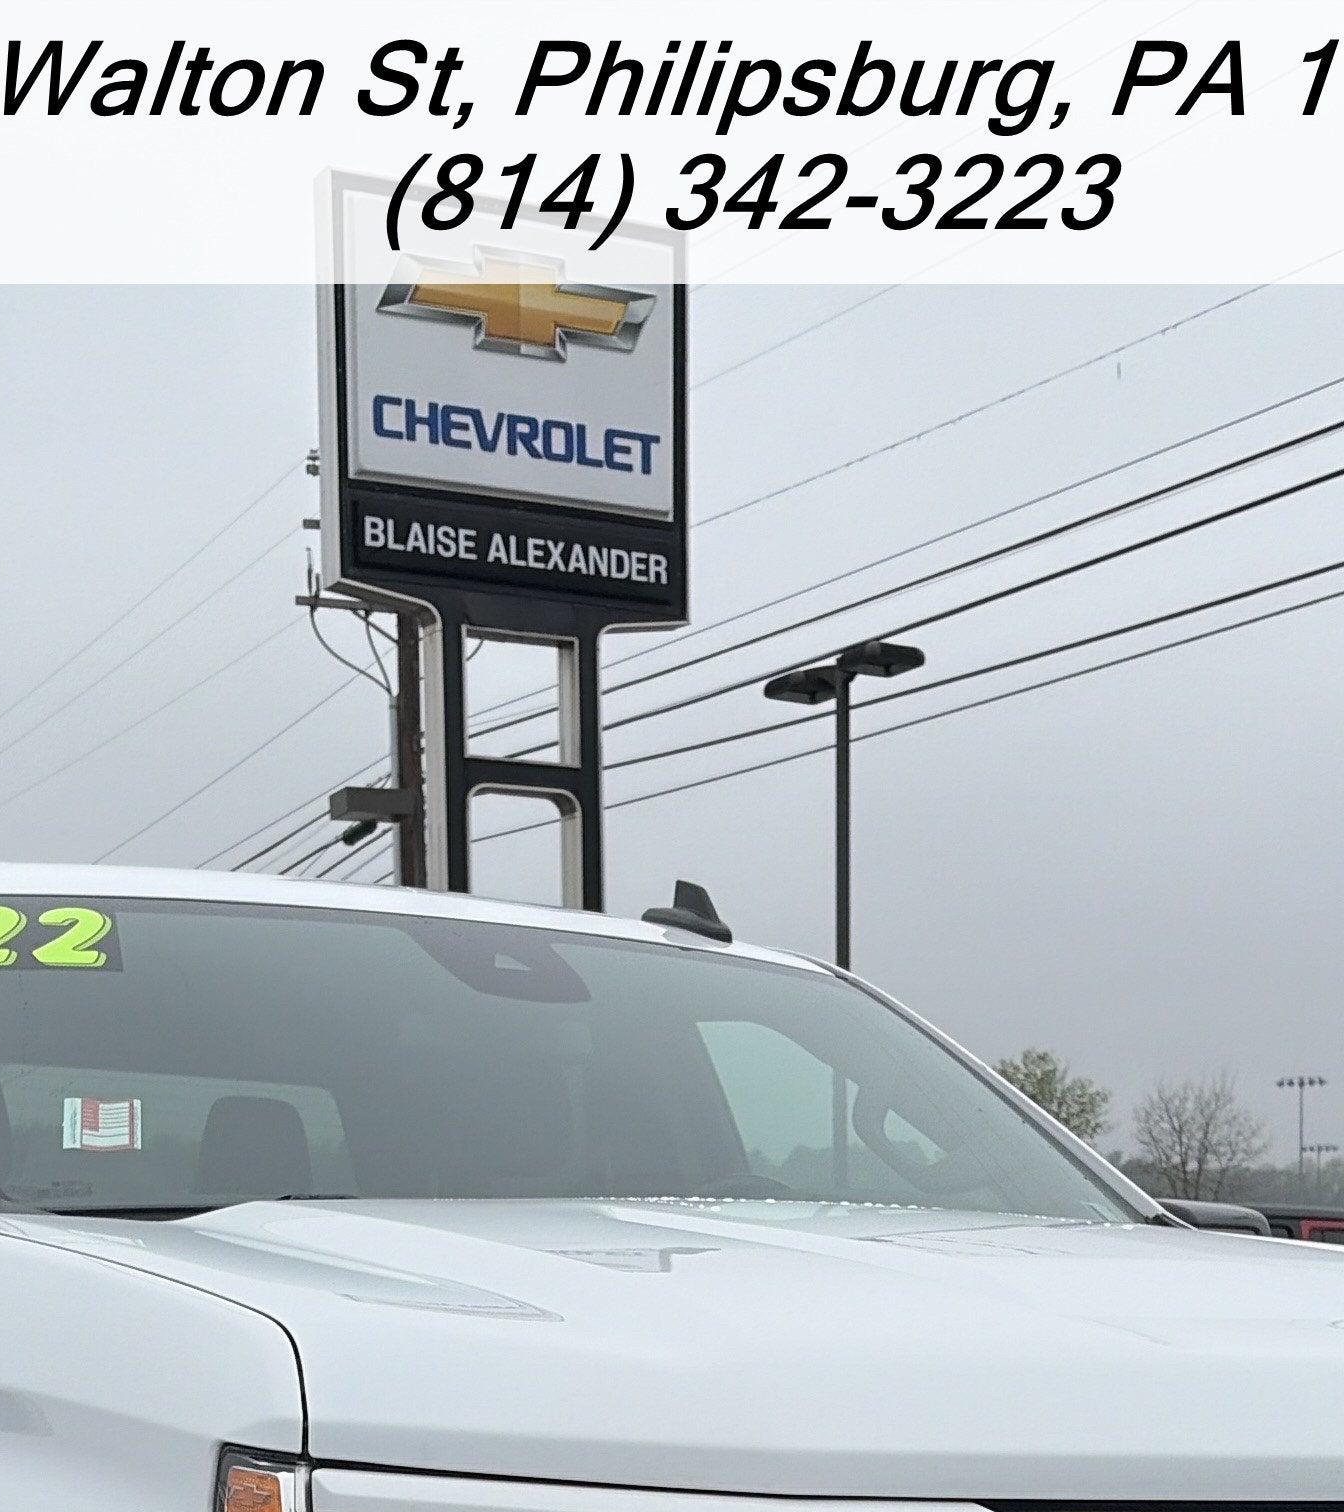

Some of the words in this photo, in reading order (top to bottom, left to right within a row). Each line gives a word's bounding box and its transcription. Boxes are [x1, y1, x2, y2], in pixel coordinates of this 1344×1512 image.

[372, 394, 661, 476] CHEVROLET
[363, 514, 478, 561] BLAISE
[486, 532, 669, 585] ALEXANDER
